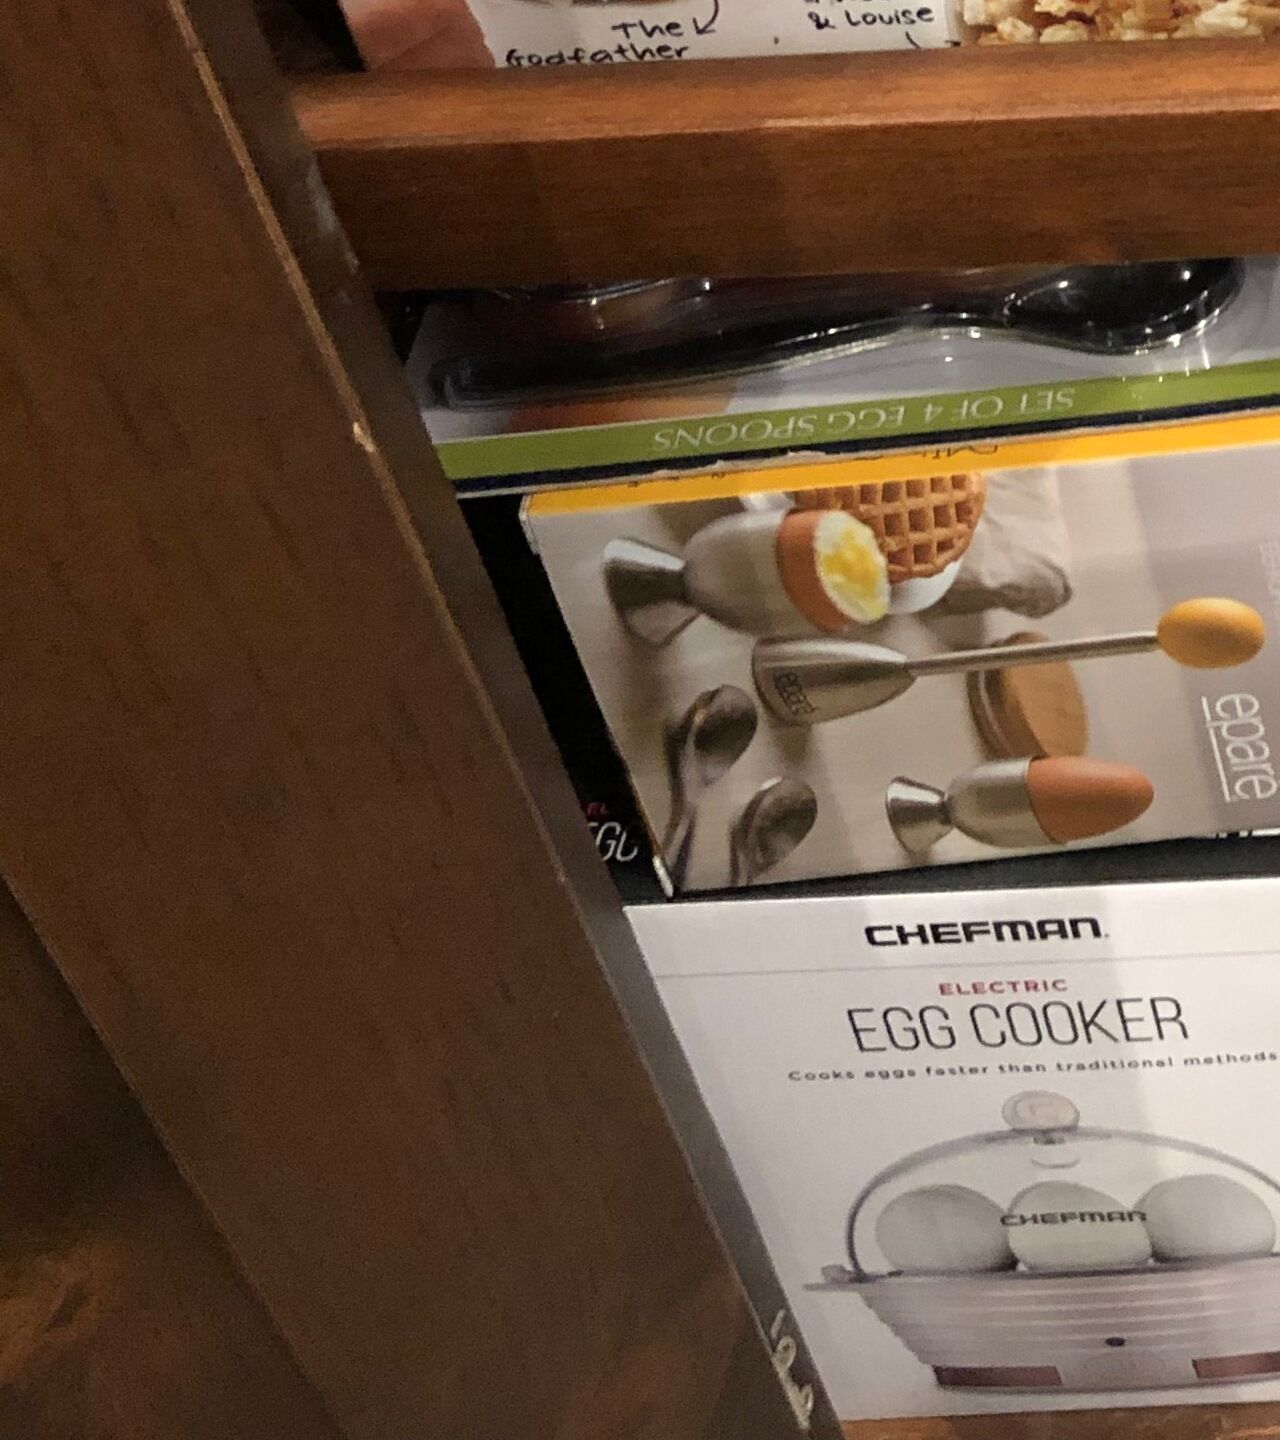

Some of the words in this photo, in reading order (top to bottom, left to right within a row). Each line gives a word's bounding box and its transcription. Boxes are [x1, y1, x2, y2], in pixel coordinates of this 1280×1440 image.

[612, 19, 685, 39] The
[924, 403, 946, 427] 4
[961, 393, 1005, 421] OF
[1018, 387, 1076, 415] SET
[653, 412, 820, 455] SPOONS
[826, 405, 907, 435] EGG
[864, 916, 1103, 947] CHEFMAN
[938, 978, 1069, 997] ELECTRIC
[847, 1004, 957, 1054] EGG
[969, 996, 1190, 1049] COOKER
[788, 1068, 856, 1082] Cooks
[864, 1066, 917, 1082] eggs
[925, 1062, 990, 1077] faster
[998, 1060, 1048, 1074] than
[1056, 1055, 1174, 1072] traditional
[1183, 1050, 1279, 1068] methods
[1000, 1208, 1147, 1228] CHEFMAN
